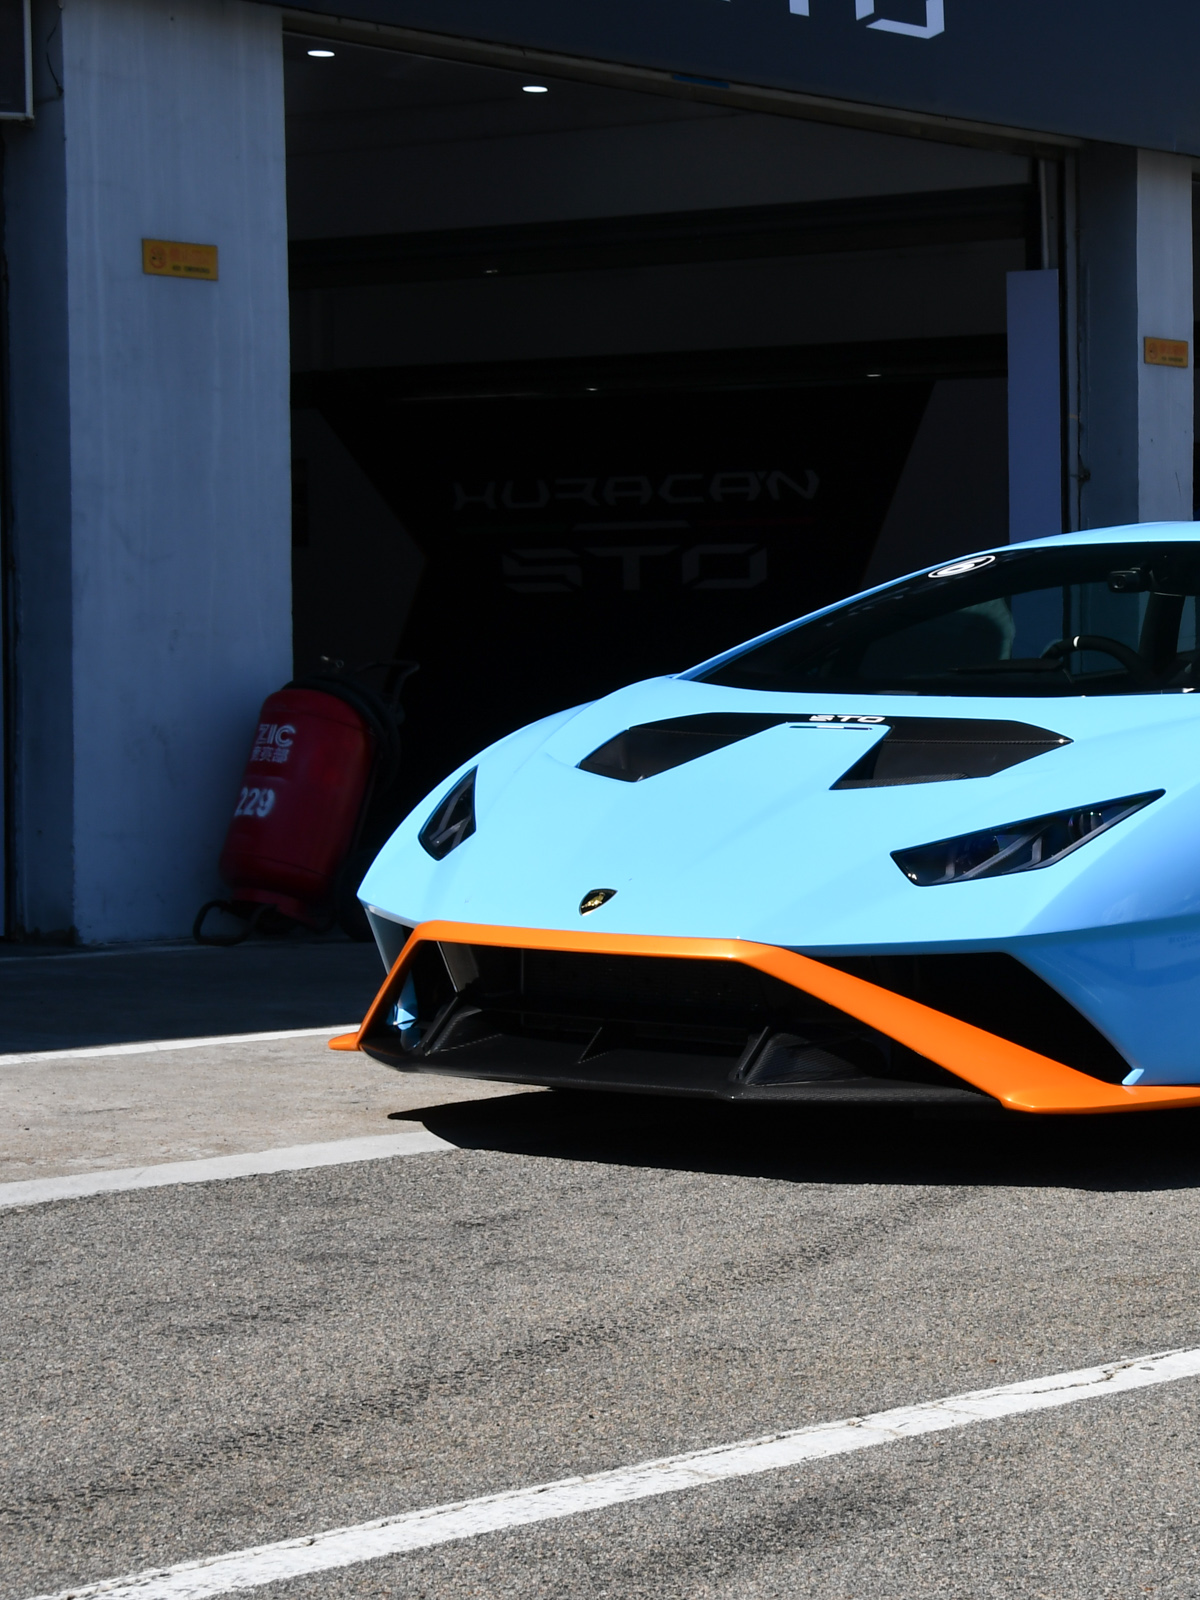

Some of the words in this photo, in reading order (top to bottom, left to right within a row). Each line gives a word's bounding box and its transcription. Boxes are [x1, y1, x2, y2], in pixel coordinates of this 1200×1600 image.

[502, 544, 767, 592] STO
[809, 715, 886, 723] STO
[235, 787, 275, 817] 229
